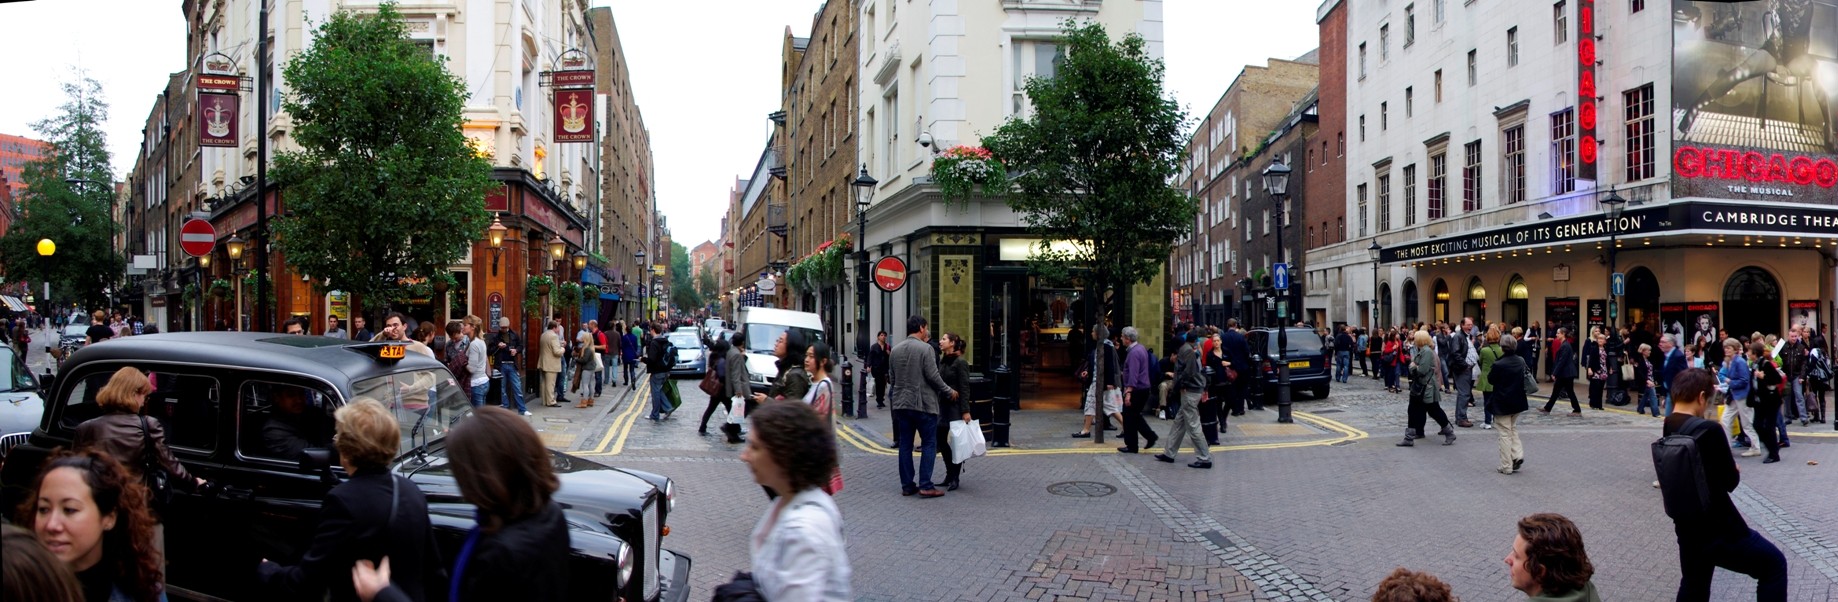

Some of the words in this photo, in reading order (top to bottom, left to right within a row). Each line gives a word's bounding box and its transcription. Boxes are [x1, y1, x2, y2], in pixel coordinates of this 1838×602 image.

[1579, 0, 1597, 164] ICAGO
[1673, 145, 1838, 188] CHICAGO
[1727, 185, 1746, 193] THE
[1750, 186, 1794, 196] MUSICAL
[1702, 211, 1798, 227] CAMBRIDGE
[1410, 246, 1429, 258] MOST
[1431, 240, 1468, 255] EXCITING
[1471, 233, 1511, 249] MUSICAL
[1516, 231, 1529, 243] OF
[1533, 227, 1550, 242] ITS
